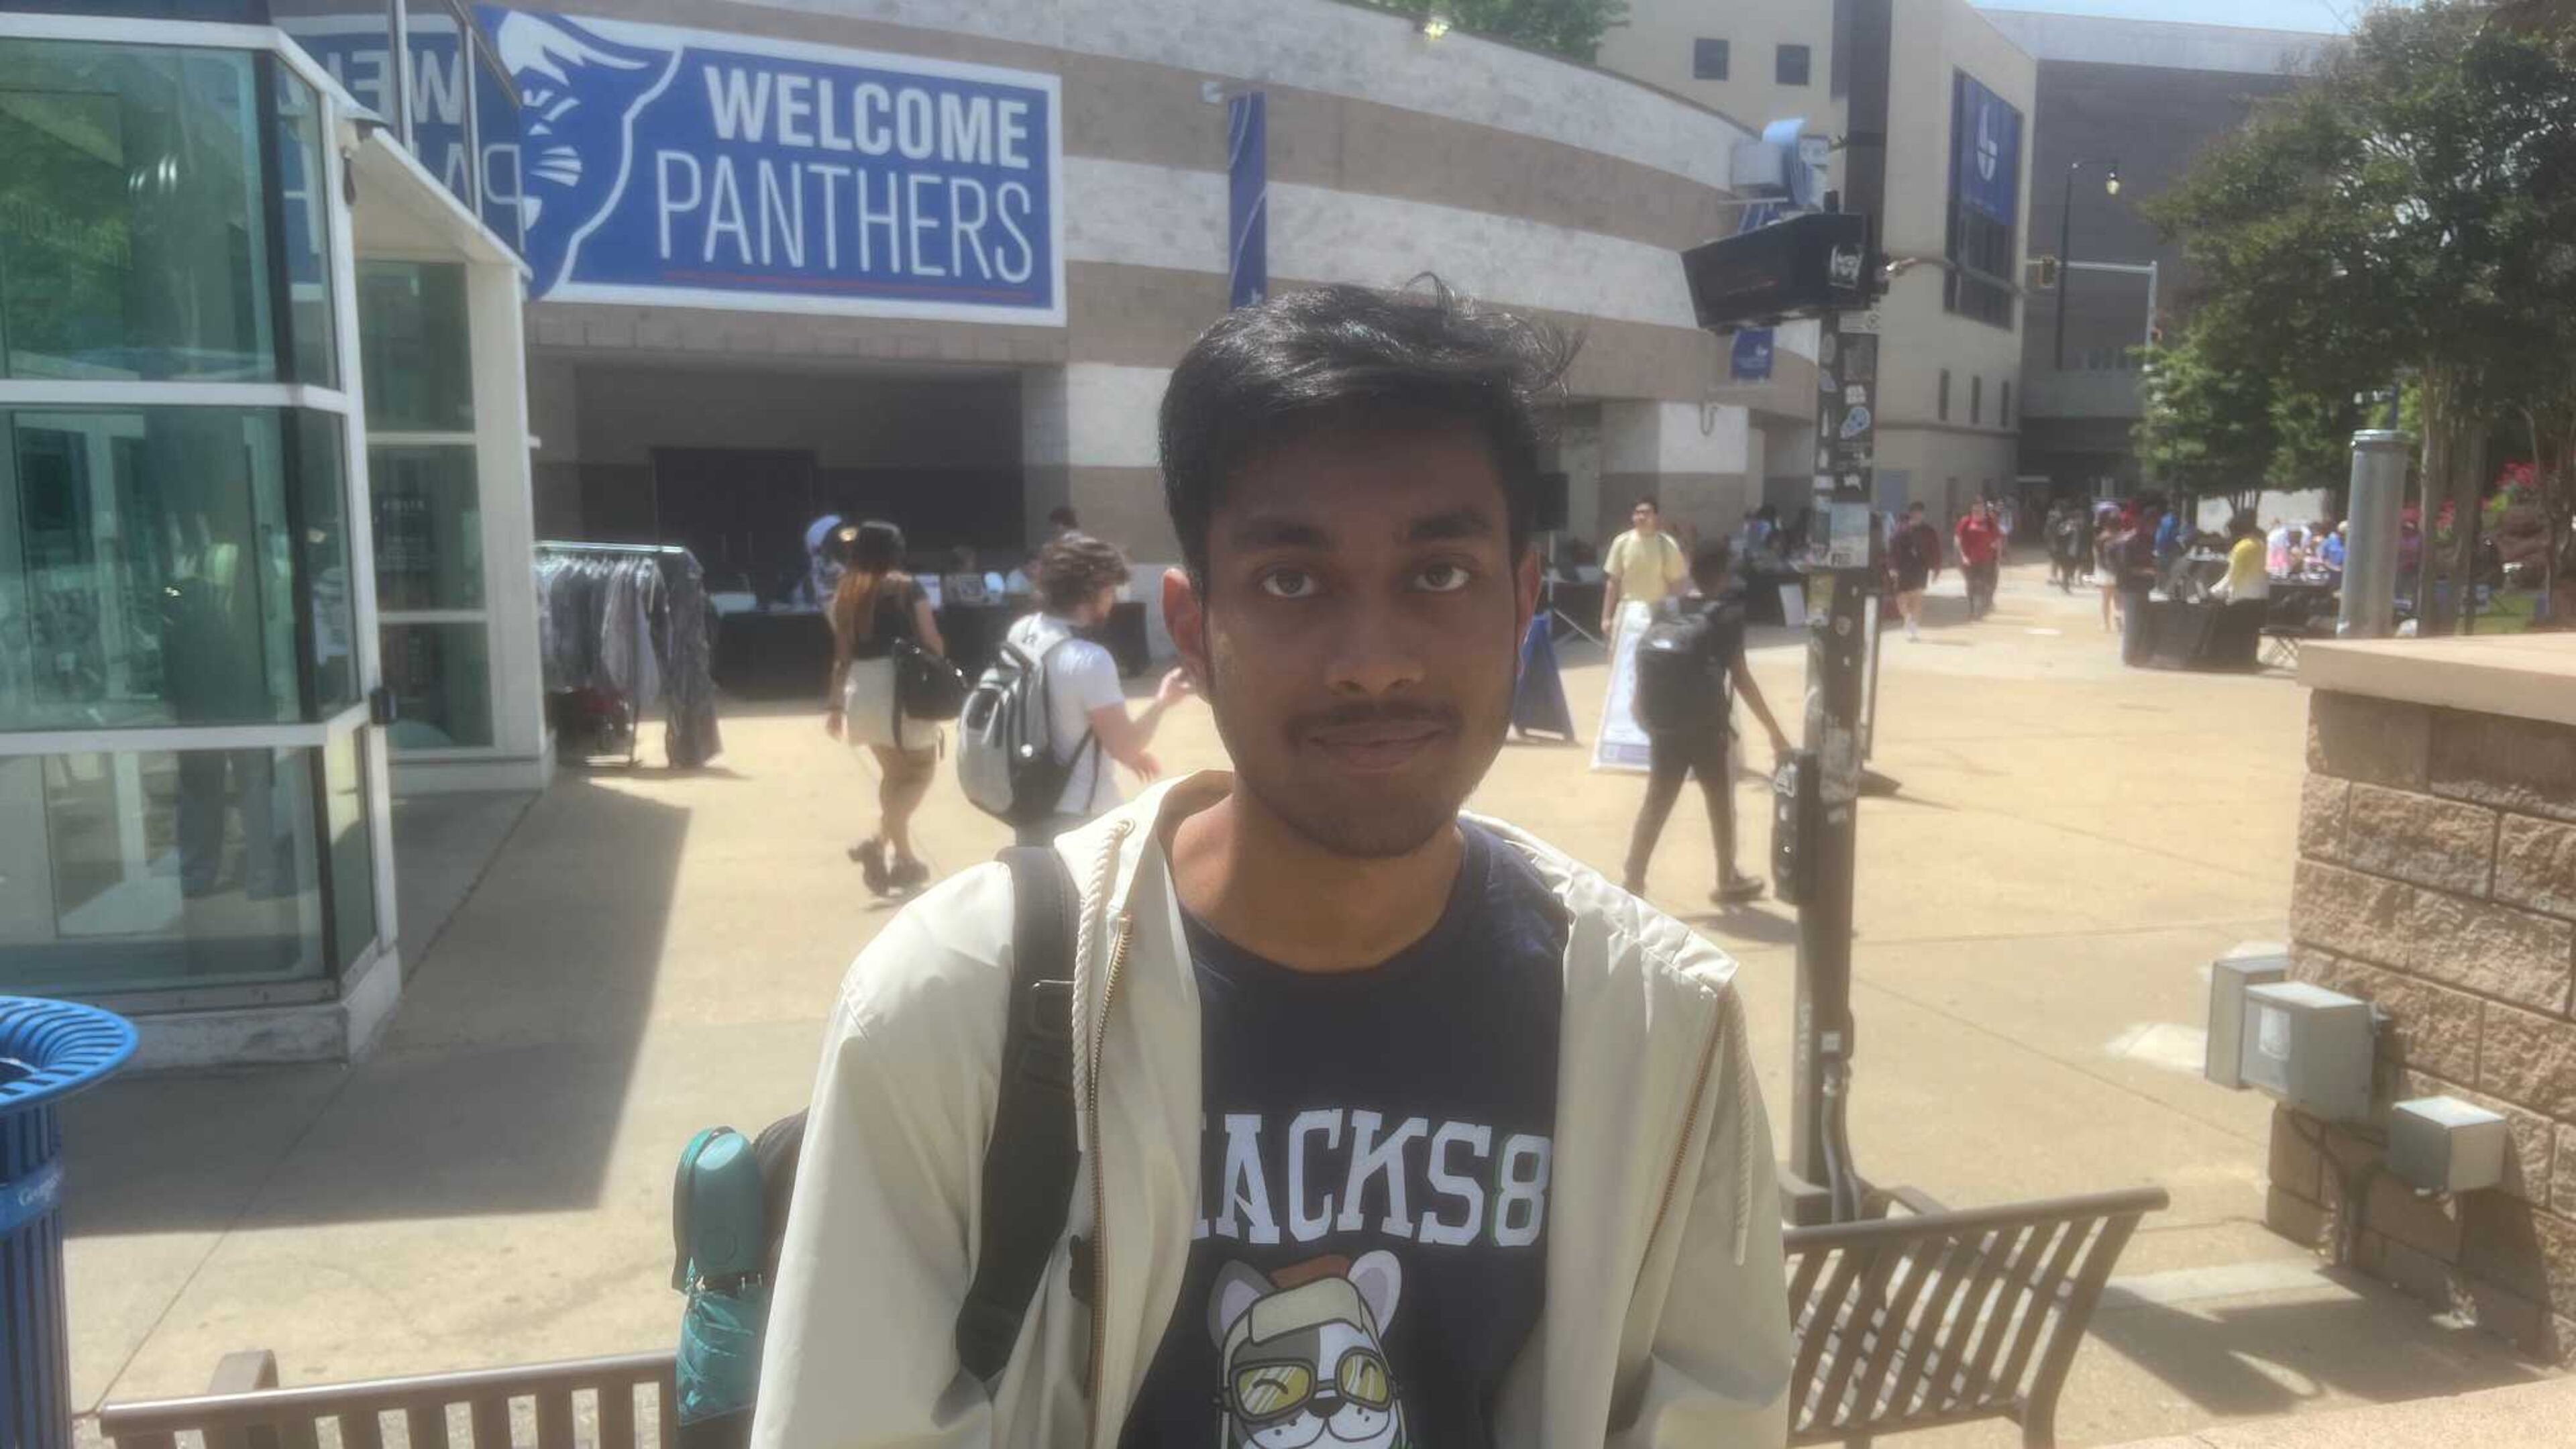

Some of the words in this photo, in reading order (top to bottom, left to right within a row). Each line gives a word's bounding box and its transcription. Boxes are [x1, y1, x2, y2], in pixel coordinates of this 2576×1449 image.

[704, 66, 1030, 170] WELCOME
[656, 150, 1033, 284] PANTHERS
[1191, 1108, 1551, 1247] ACKS8
